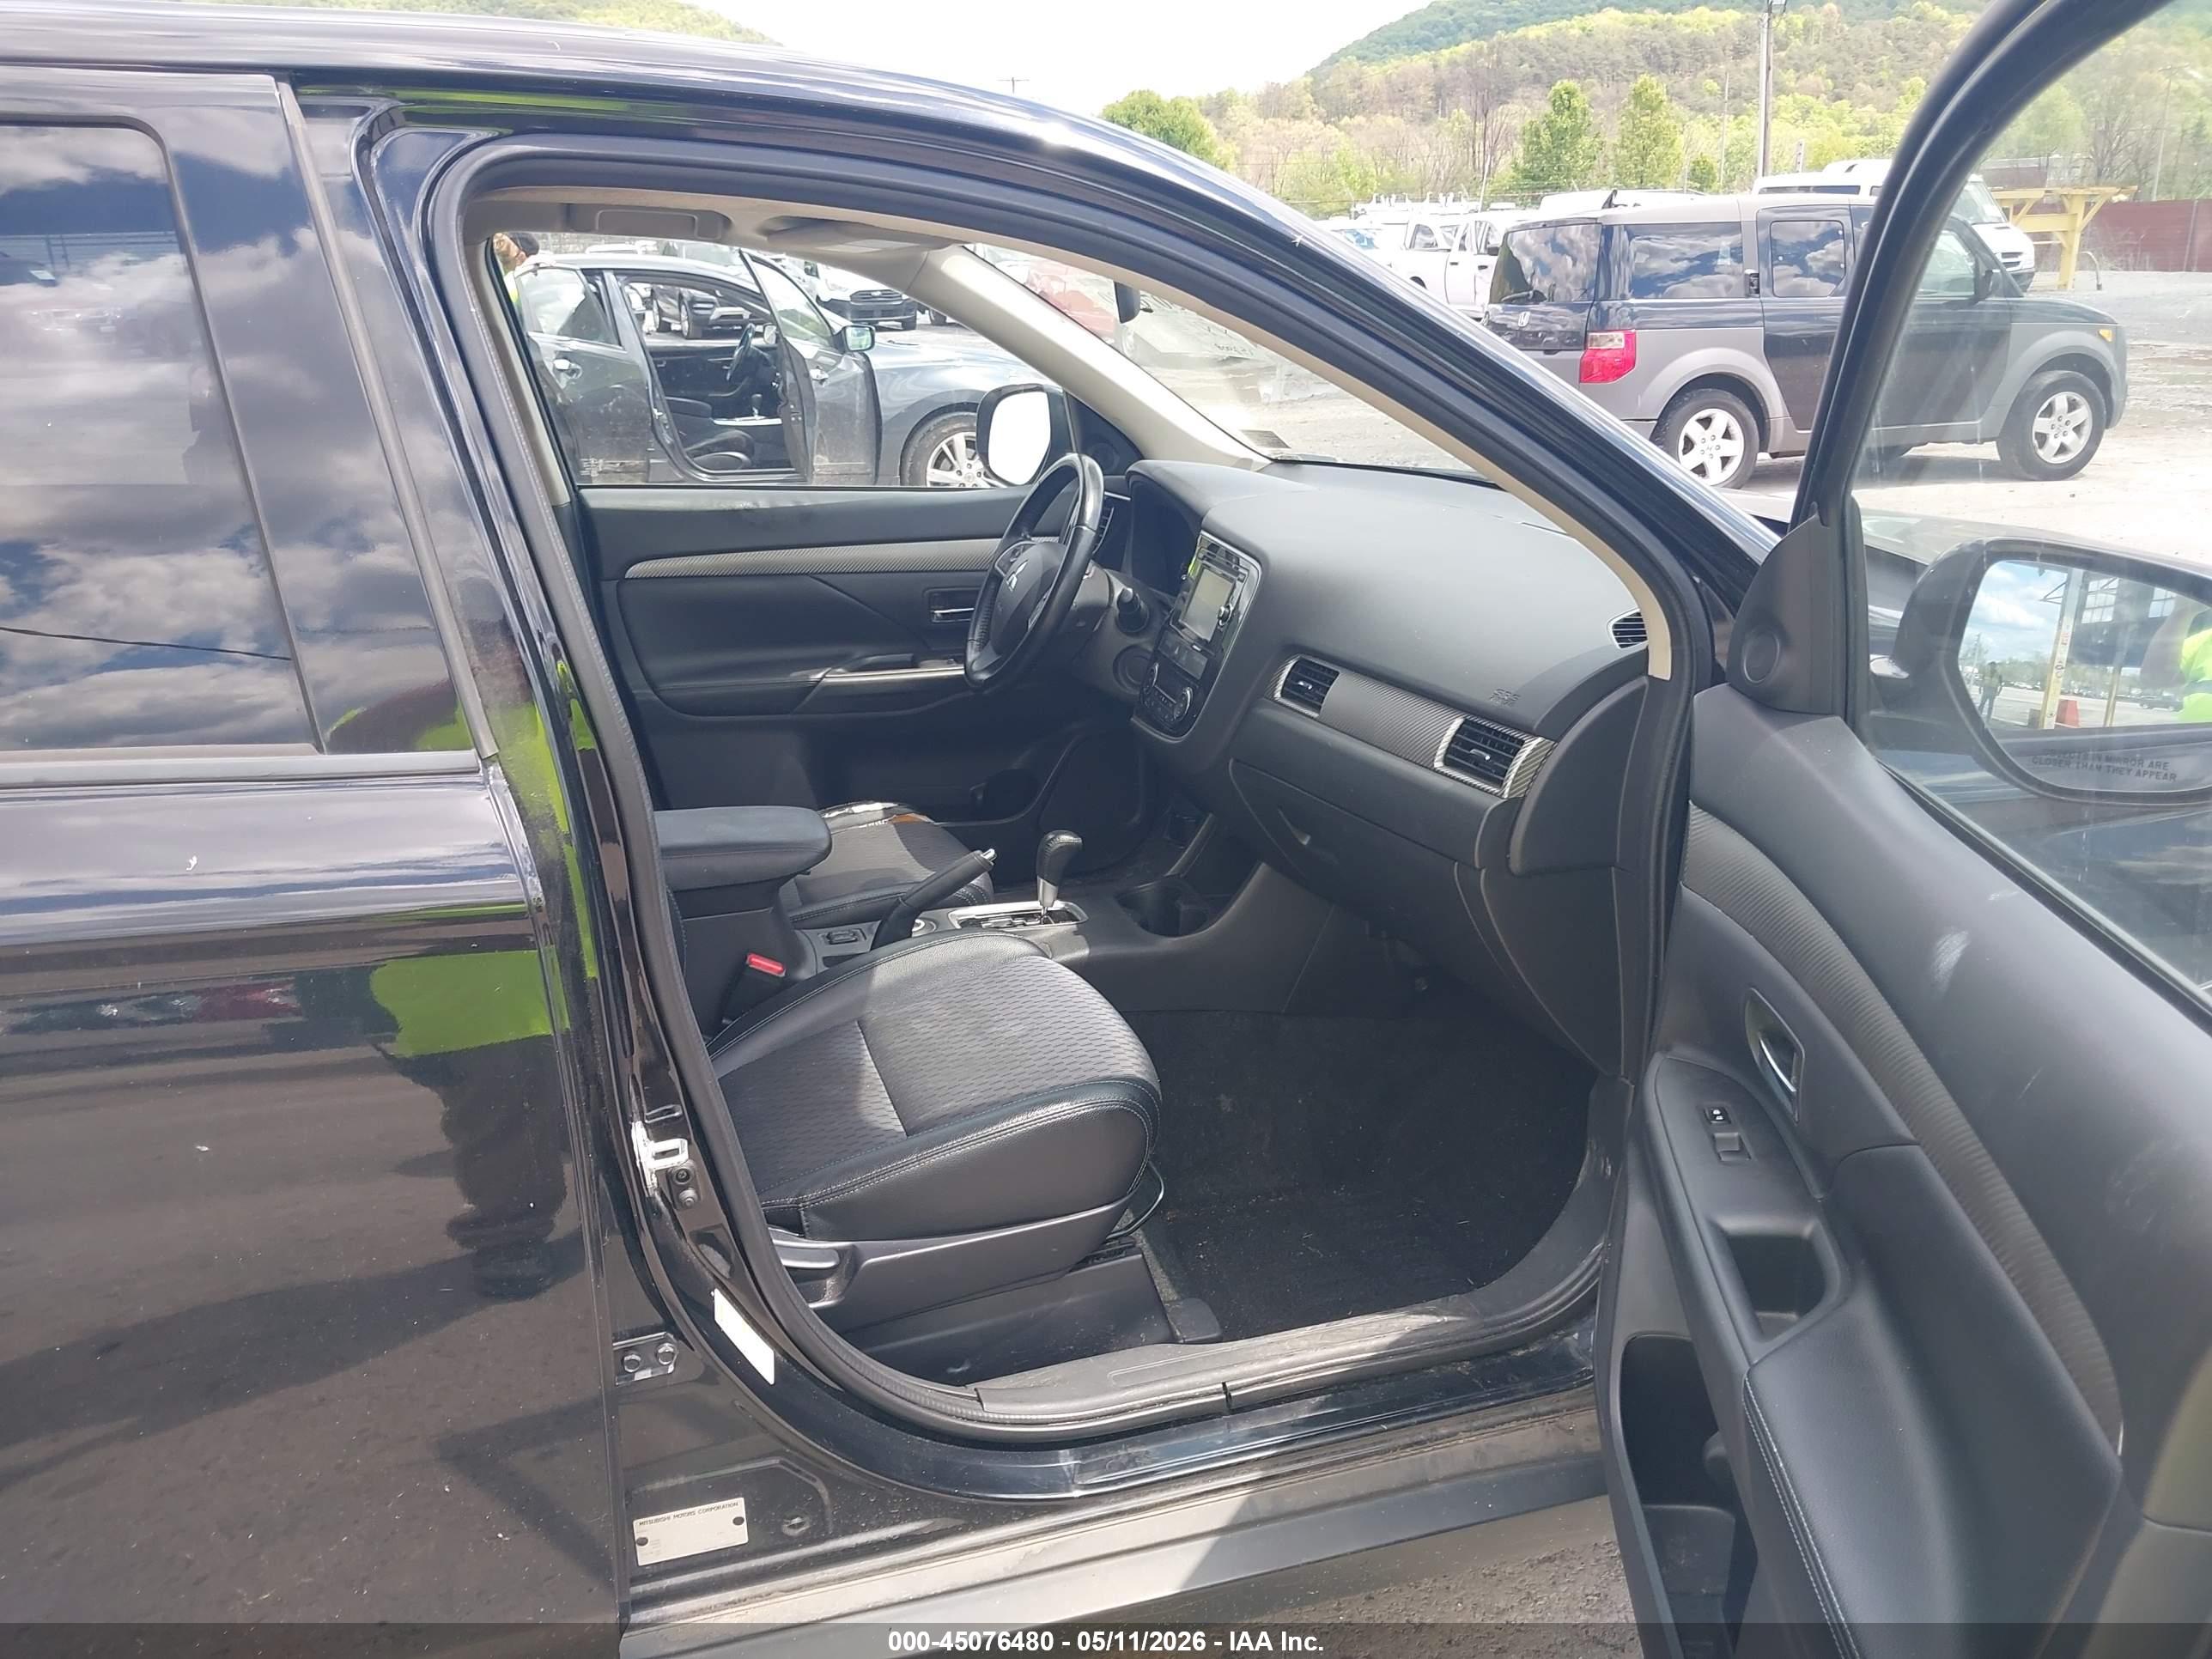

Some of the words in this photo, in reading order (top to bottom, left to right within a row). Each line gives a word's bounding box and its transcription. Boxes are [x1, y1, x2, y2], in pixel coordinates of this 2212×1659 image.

[2031, 756, 2070, 768] CLOSER
[2106, 763, 2132, 776] THEY
[2135, 769, 2178, 782] APPEAR
[2148, 760, 2171, 771] ARE
